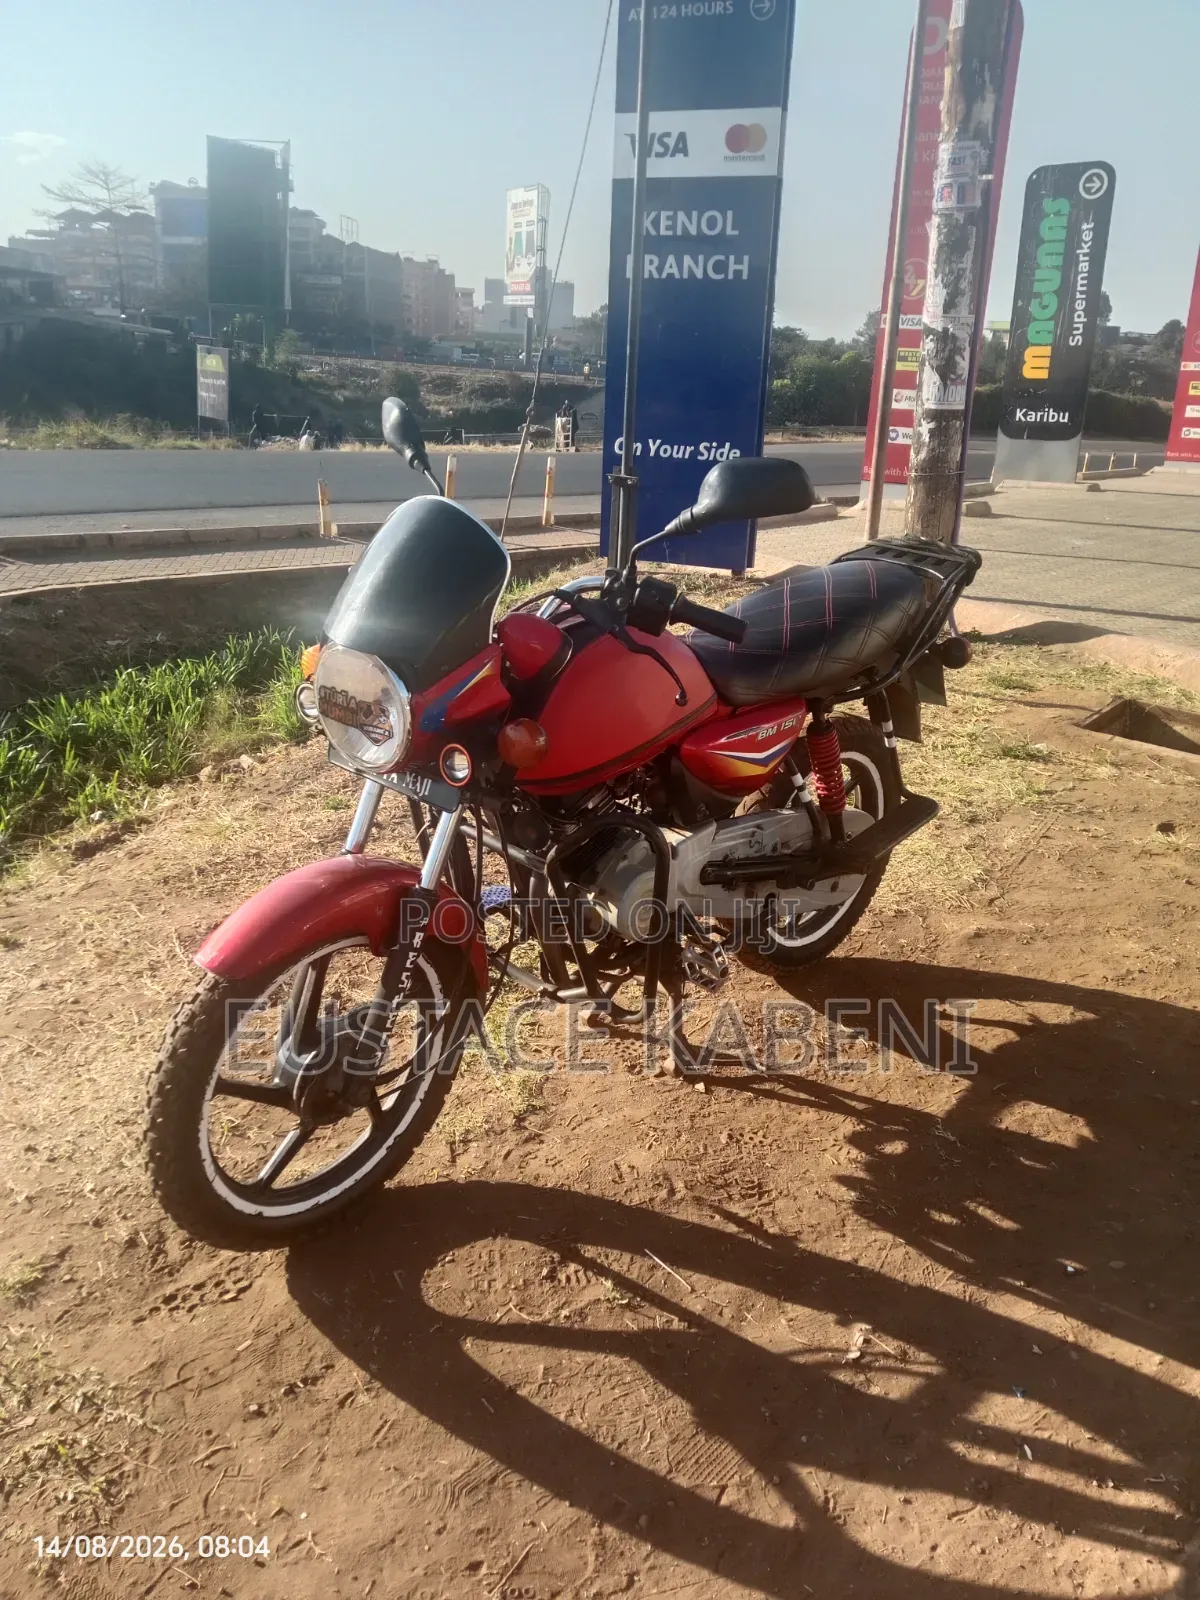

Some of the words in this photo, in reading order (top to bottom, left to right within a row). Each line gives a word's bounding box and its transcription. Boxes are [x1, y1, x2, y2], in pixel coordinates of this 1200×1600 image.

[628, 6, 657, 22] AT
[660, 4, 677, 19] 24
[681, 1, 734, 18] HOURS
[723, 153, 766, 163] mastercard
[642, 210, 740, 237] KENOL
[1069, 221, 1095, 347] Supermarket
[1015, 408, 1069, 423] Karibu
[648, 439, 695, 459] Your
[697, 441, 742, 462] Side
[758, 726, 778, 741] BM
